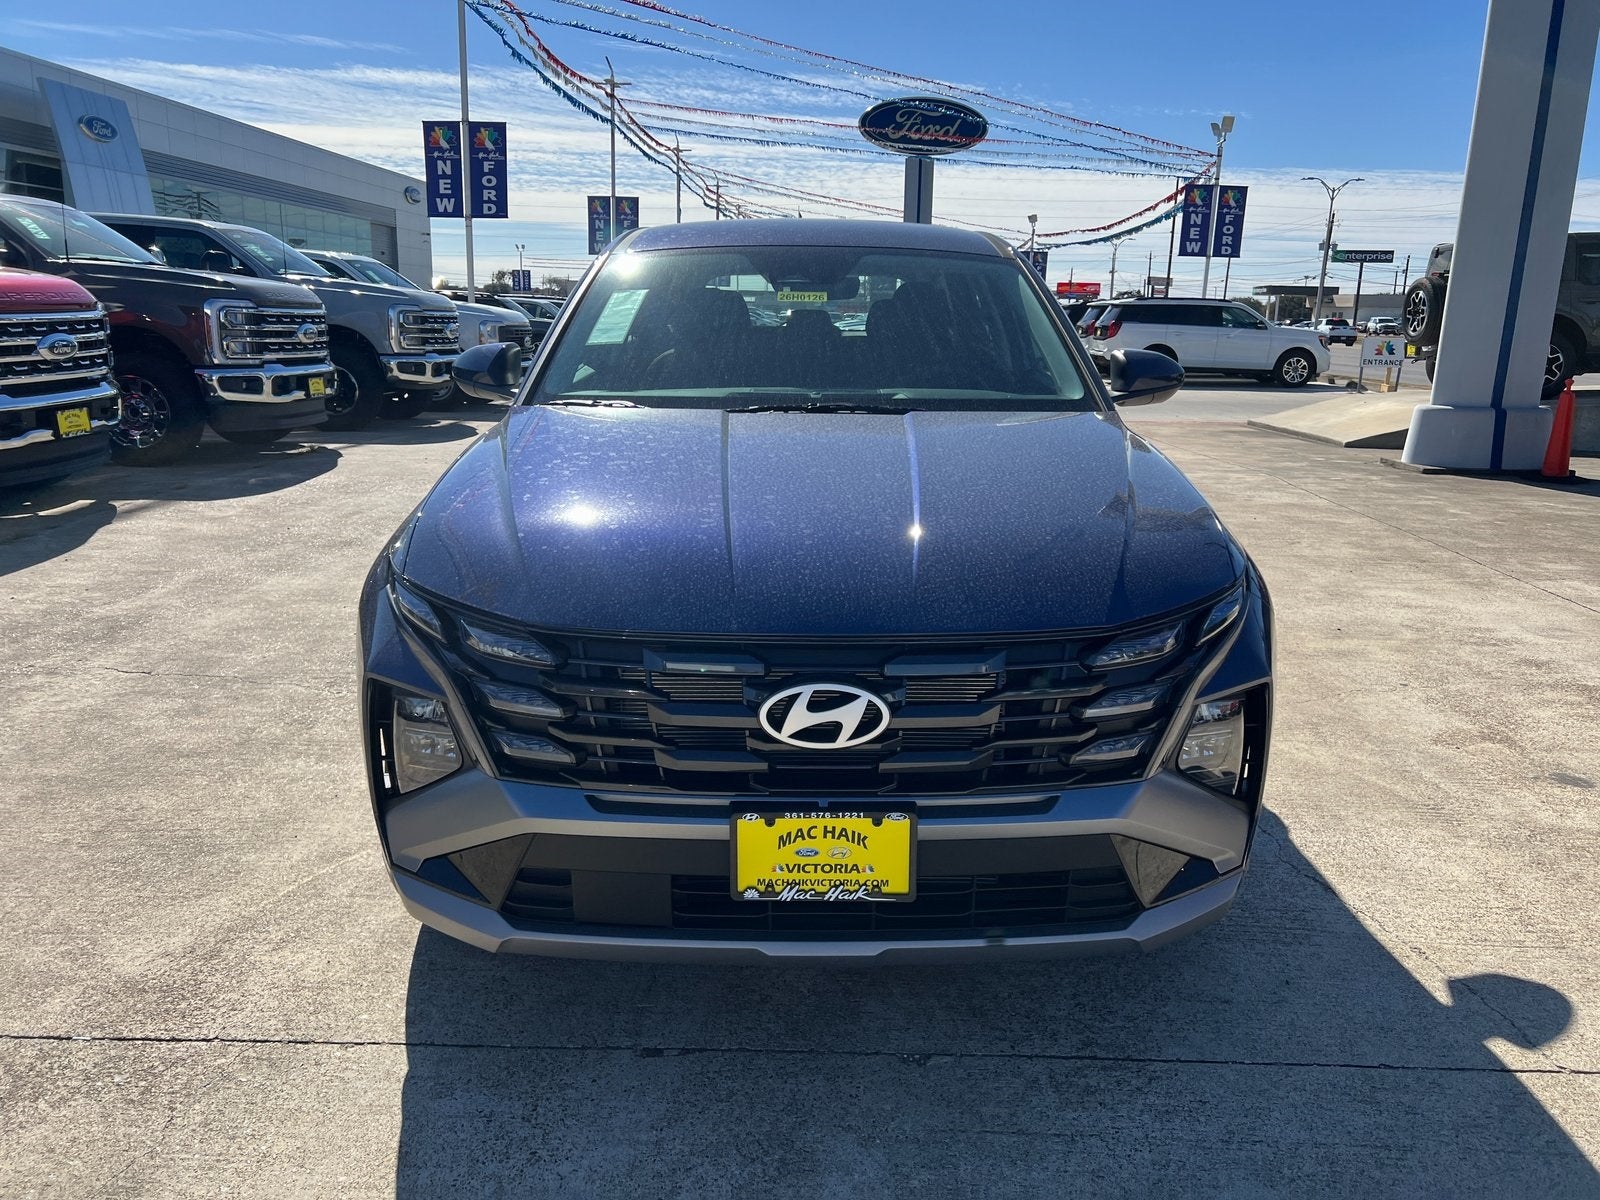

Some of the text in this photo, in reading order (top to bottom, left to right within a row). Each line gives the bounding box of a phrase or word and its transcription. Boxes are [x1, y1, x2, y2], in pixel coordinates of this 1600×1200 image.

[888, 108, 962, 141] Ford
[435, 159, 456, 213] NEW
[481, 161, 497, 215] FORD
[1185, 213, 1202, 253] NEW
[1221, 214, 1235, 255] FORD
[1336, 252, 1393, 261] enterprise
[779, 293, 825, 301] 26H0126
[777, 825, 869, 850] MAC HAIK
[785, 863, 861, 874] VICTORIA
[777, 885, 872, 902] Mac Haik
